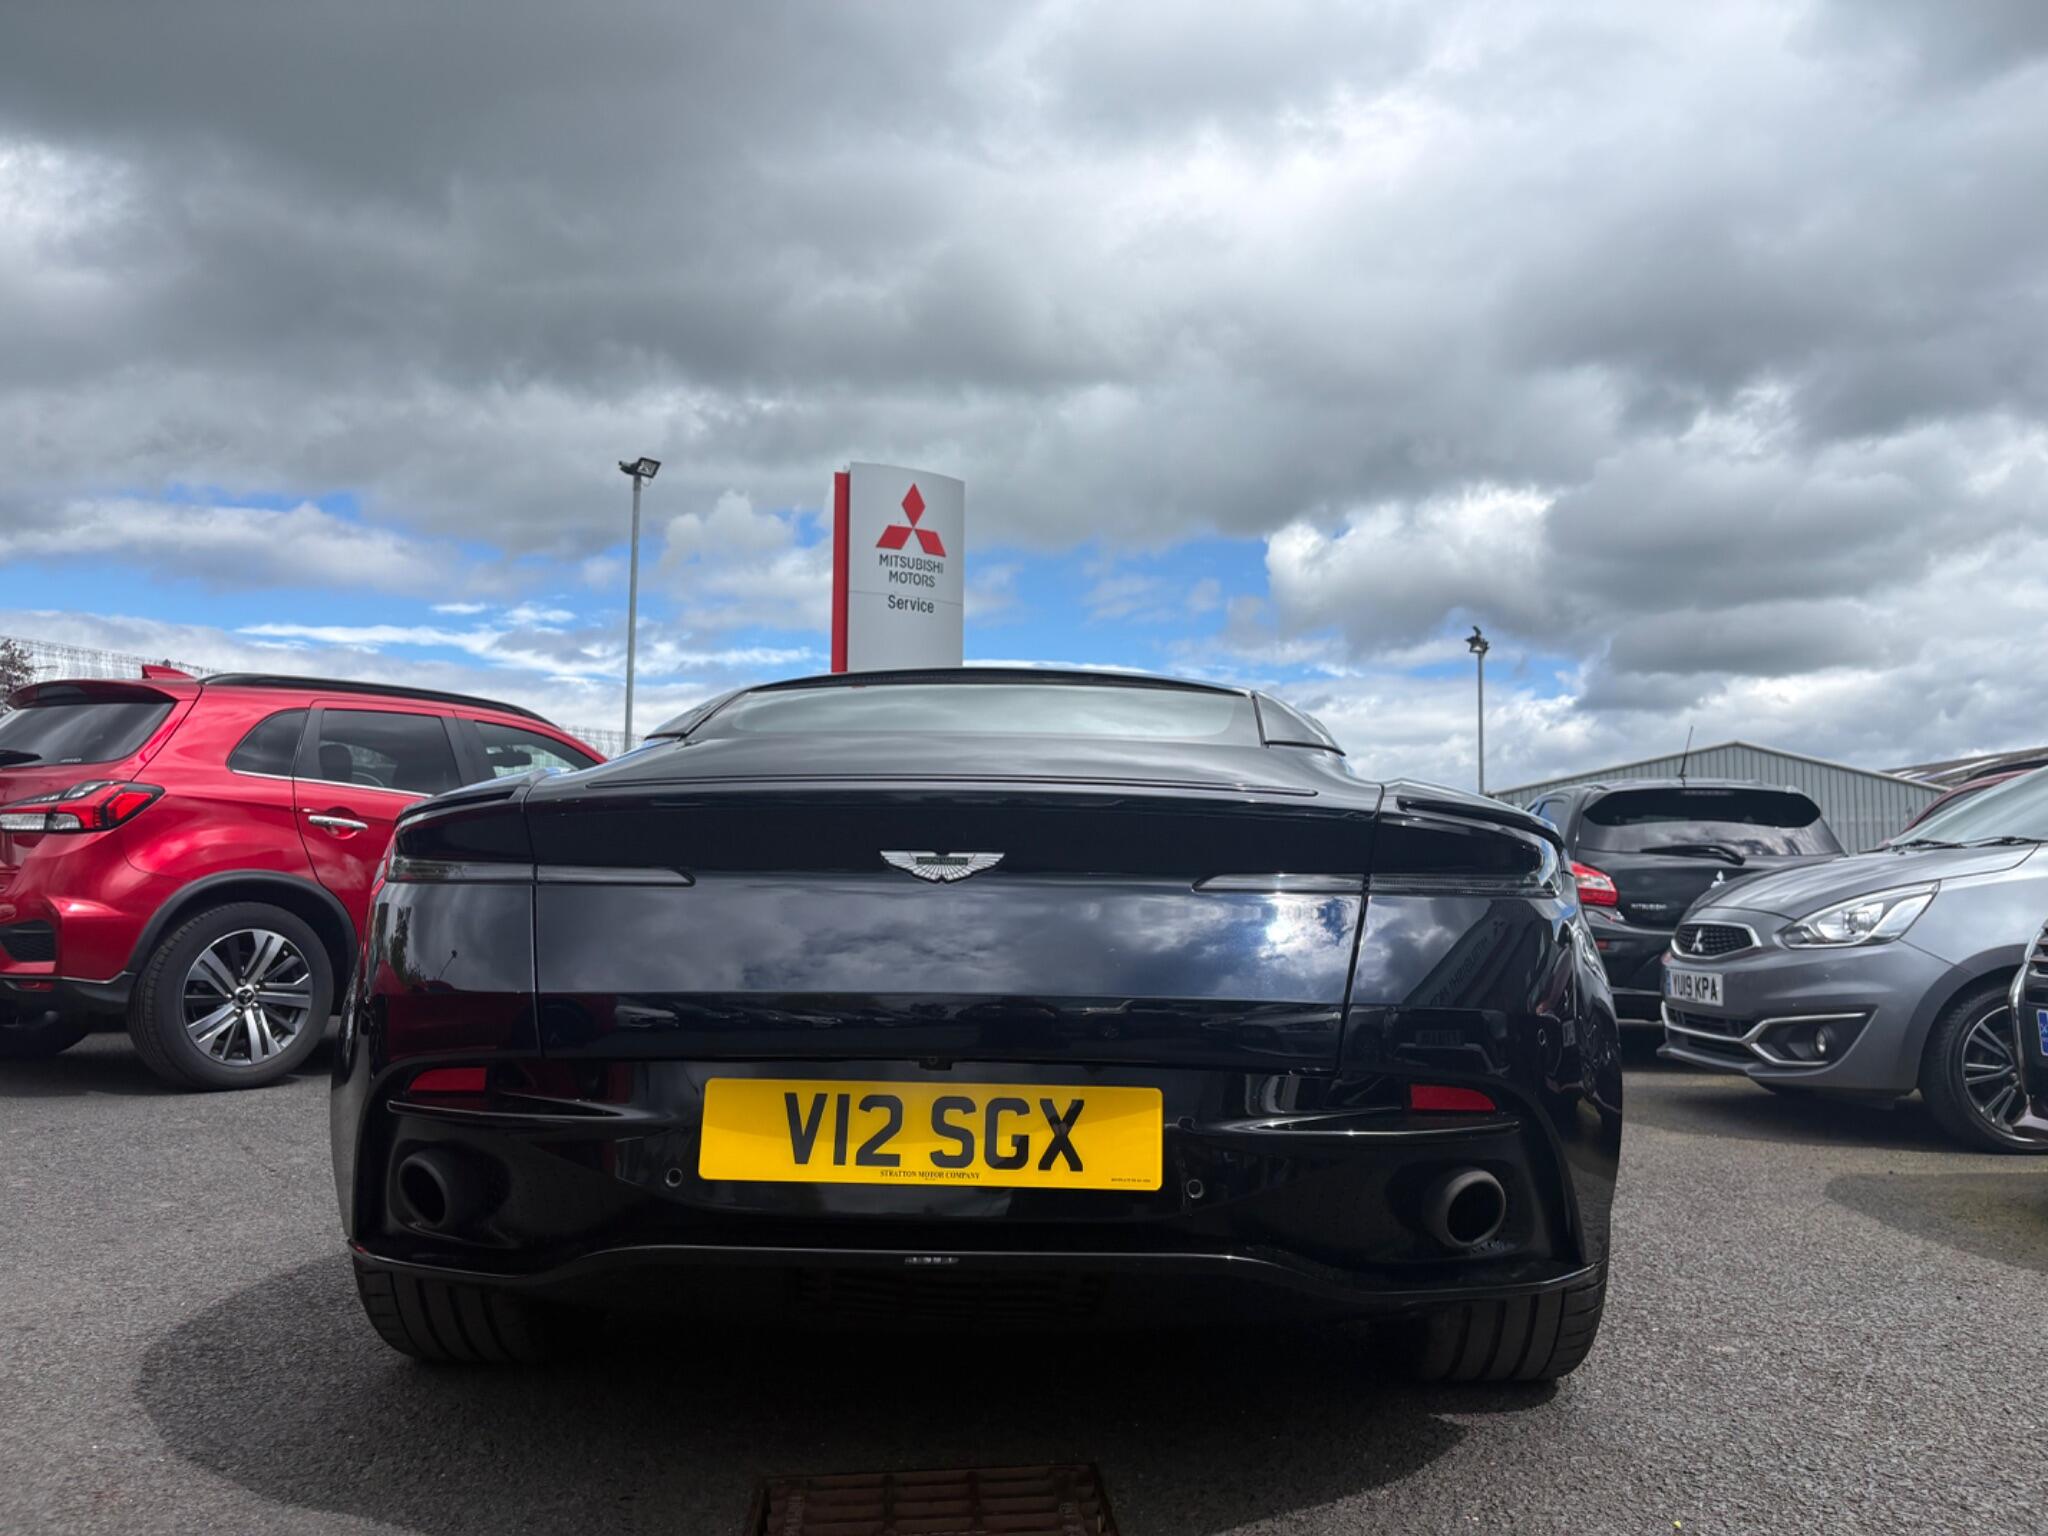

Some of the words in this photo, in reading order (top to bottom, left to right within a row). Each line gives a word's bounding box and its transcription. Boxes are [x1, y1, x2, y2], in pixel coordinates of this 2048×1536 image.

[879, 554, 944, 574] MITSUBISHI
[889, 571, 935, 588] MOTORS
[887, 594, 934, 614] Service
[1694, 976, 1718, 1001] KPA
[784, 1092, 903, 1167] V12
[929, 1095, 1084, 1172] SGX
